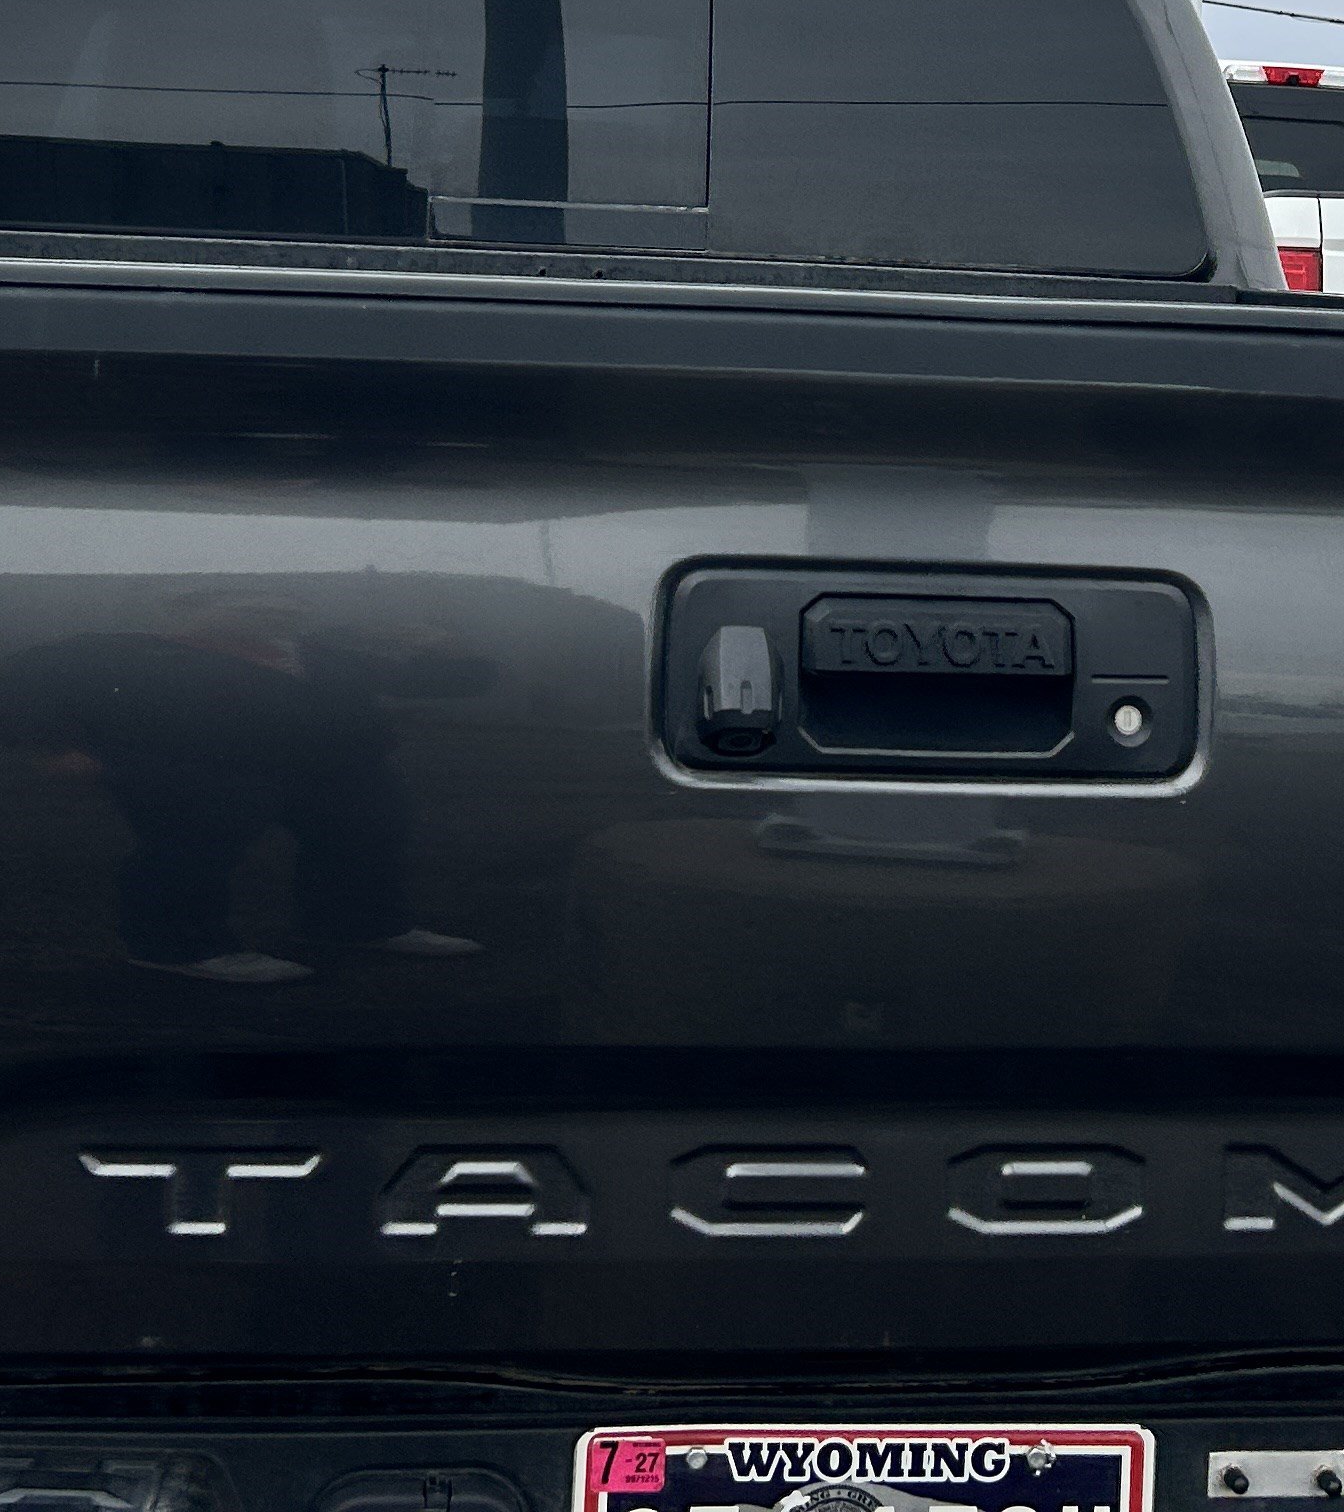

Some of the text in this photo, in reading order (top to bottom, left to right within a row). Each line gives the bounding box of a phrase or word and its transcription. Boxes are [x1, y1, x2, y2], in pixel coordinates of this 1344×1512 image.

[828, 619, 1056, 670] TOYOTA
[600, 1441, 619, 1484] 7
[725, 1438, 1009, 1481] WYOMING
